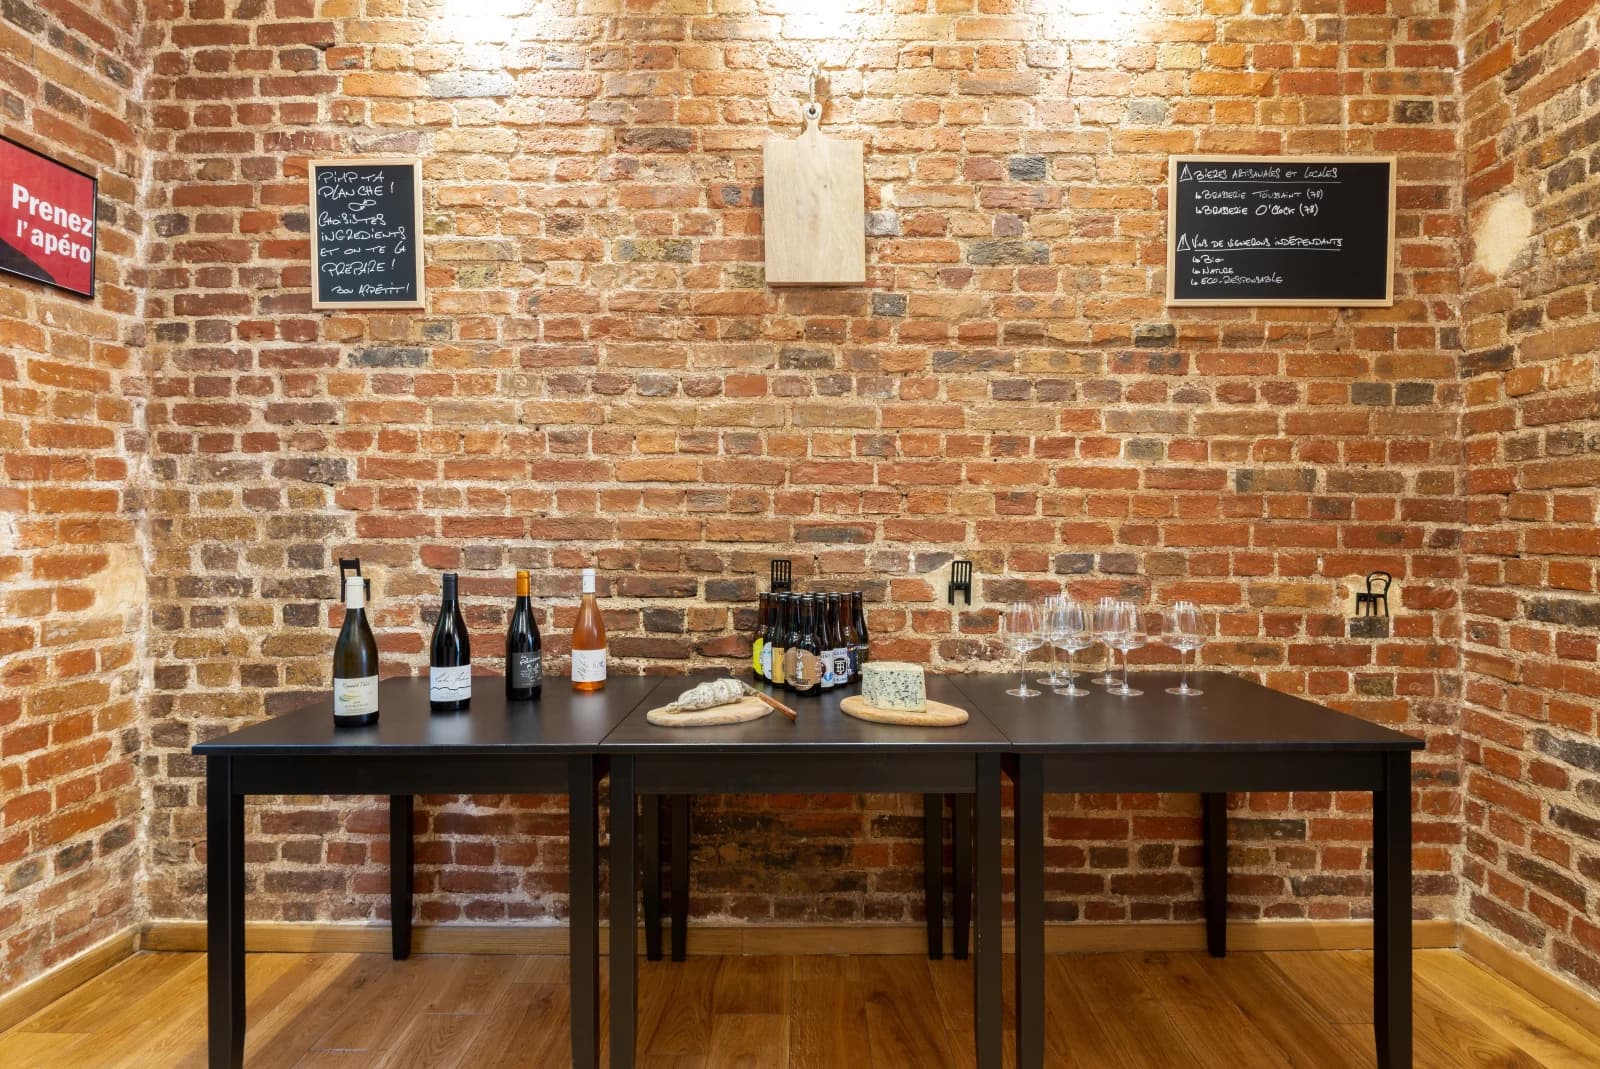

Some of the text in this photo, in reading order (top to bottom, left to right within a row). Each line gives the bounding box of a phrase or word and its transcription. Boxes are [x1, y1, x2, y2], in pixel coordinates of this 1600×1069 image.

[1304, 166, 1337, 178] LOCALES
[1307, 188, 1323, 199] (78)
[12, 183, 93, 238] Prenez
[1300, 203, 1318, 216] (78)
[320, 248, 339, 256] ET
